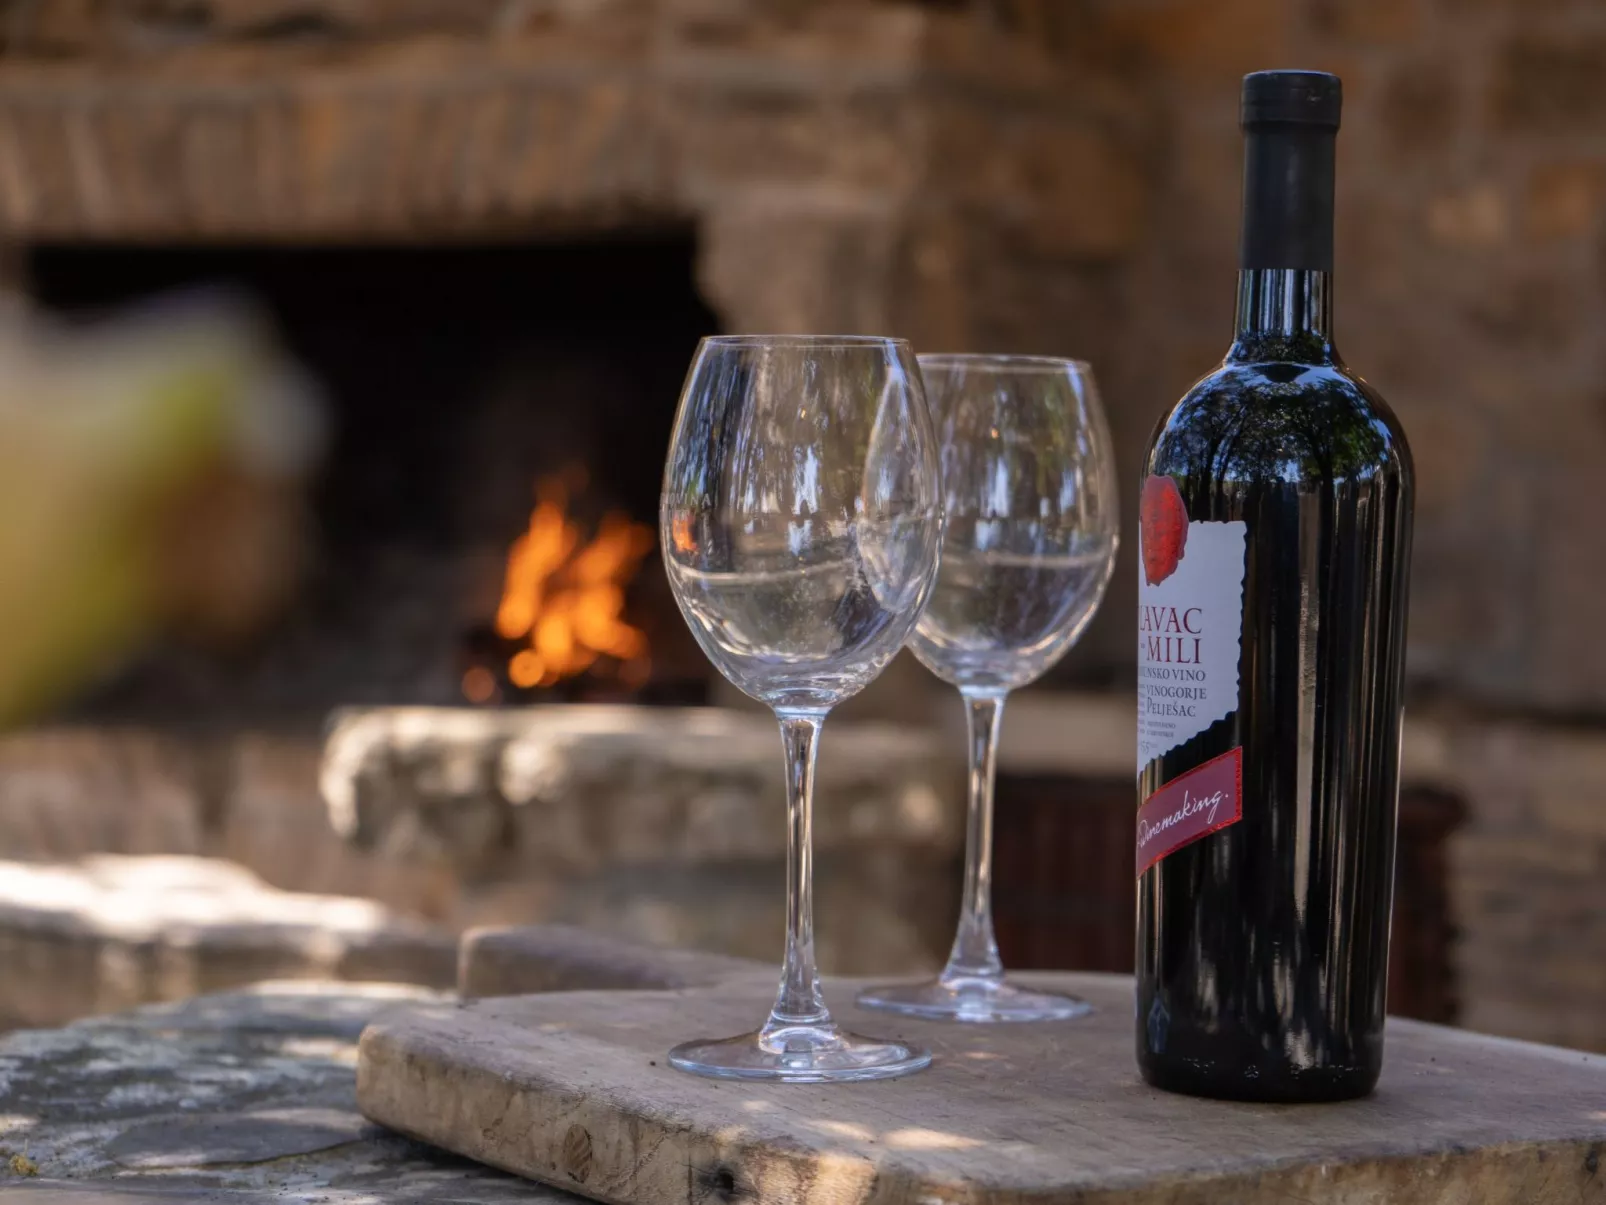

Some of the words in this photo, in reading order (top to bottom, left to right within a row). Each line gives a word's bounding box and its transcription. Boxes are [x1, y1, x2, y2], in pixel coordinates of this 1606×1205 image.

[1147, 636, 1202, 664] MILI
[1172, 669, 1206, 681] VINO
[1146, 684, 1207, 700] VINOGORJE
